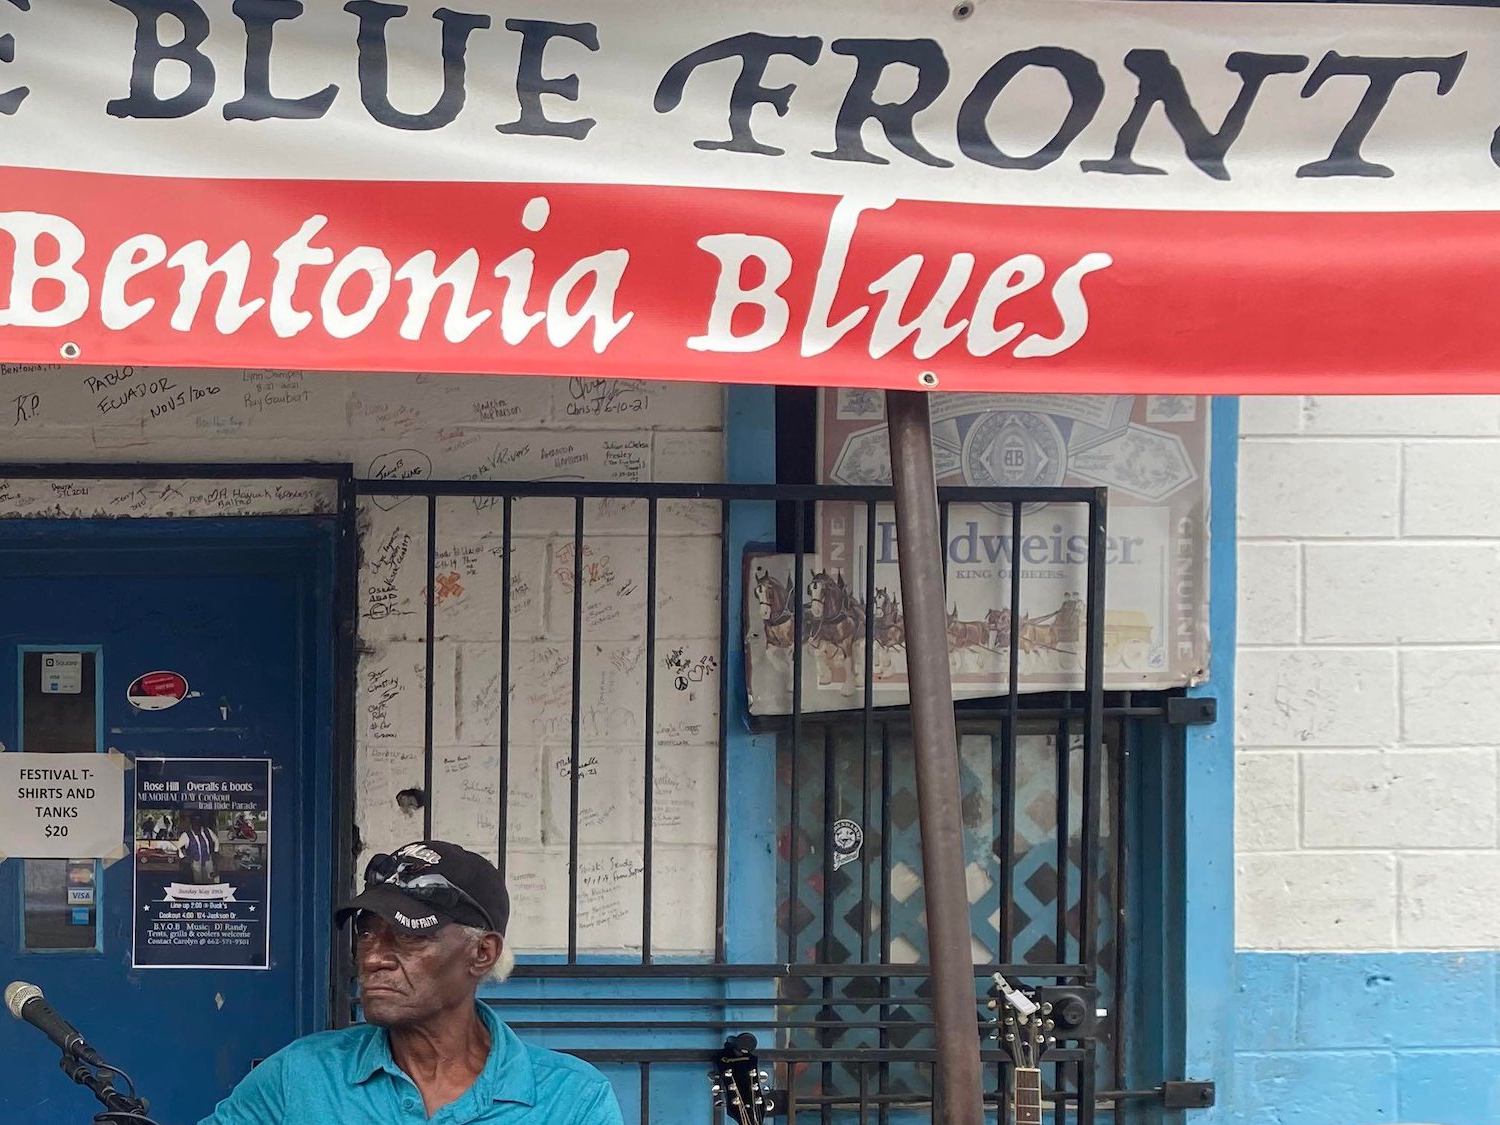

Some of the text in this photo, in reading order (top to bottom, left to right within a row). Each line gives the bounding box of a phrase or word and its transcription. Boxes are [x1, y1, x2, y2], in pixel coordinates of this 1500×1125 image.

[106, 0, 600, 141] BLUE
[653, 30, 1468, 181] FRONT
[687, 196, 1112, 360] Blues
[84, 366, 134, 395] PABLO
[97, 377, 177, 415] ECUADOR
[1176, 516, 1195, 659] GENUINE
[19, 769, 94, 780] FESTIVAL T-
[18, 788, 96, 799] SHIRTS AND
[144, 781, 253, 792] Rose Hill Overalls & boots
[35, 807, 78, 818] TANKS
[45, 825, 69, 839] $20
[187, 923, 208, 931] Music
[225, 923, 248, 932] Randy
[394, 911, 439, 930] MAN OF FAITH
